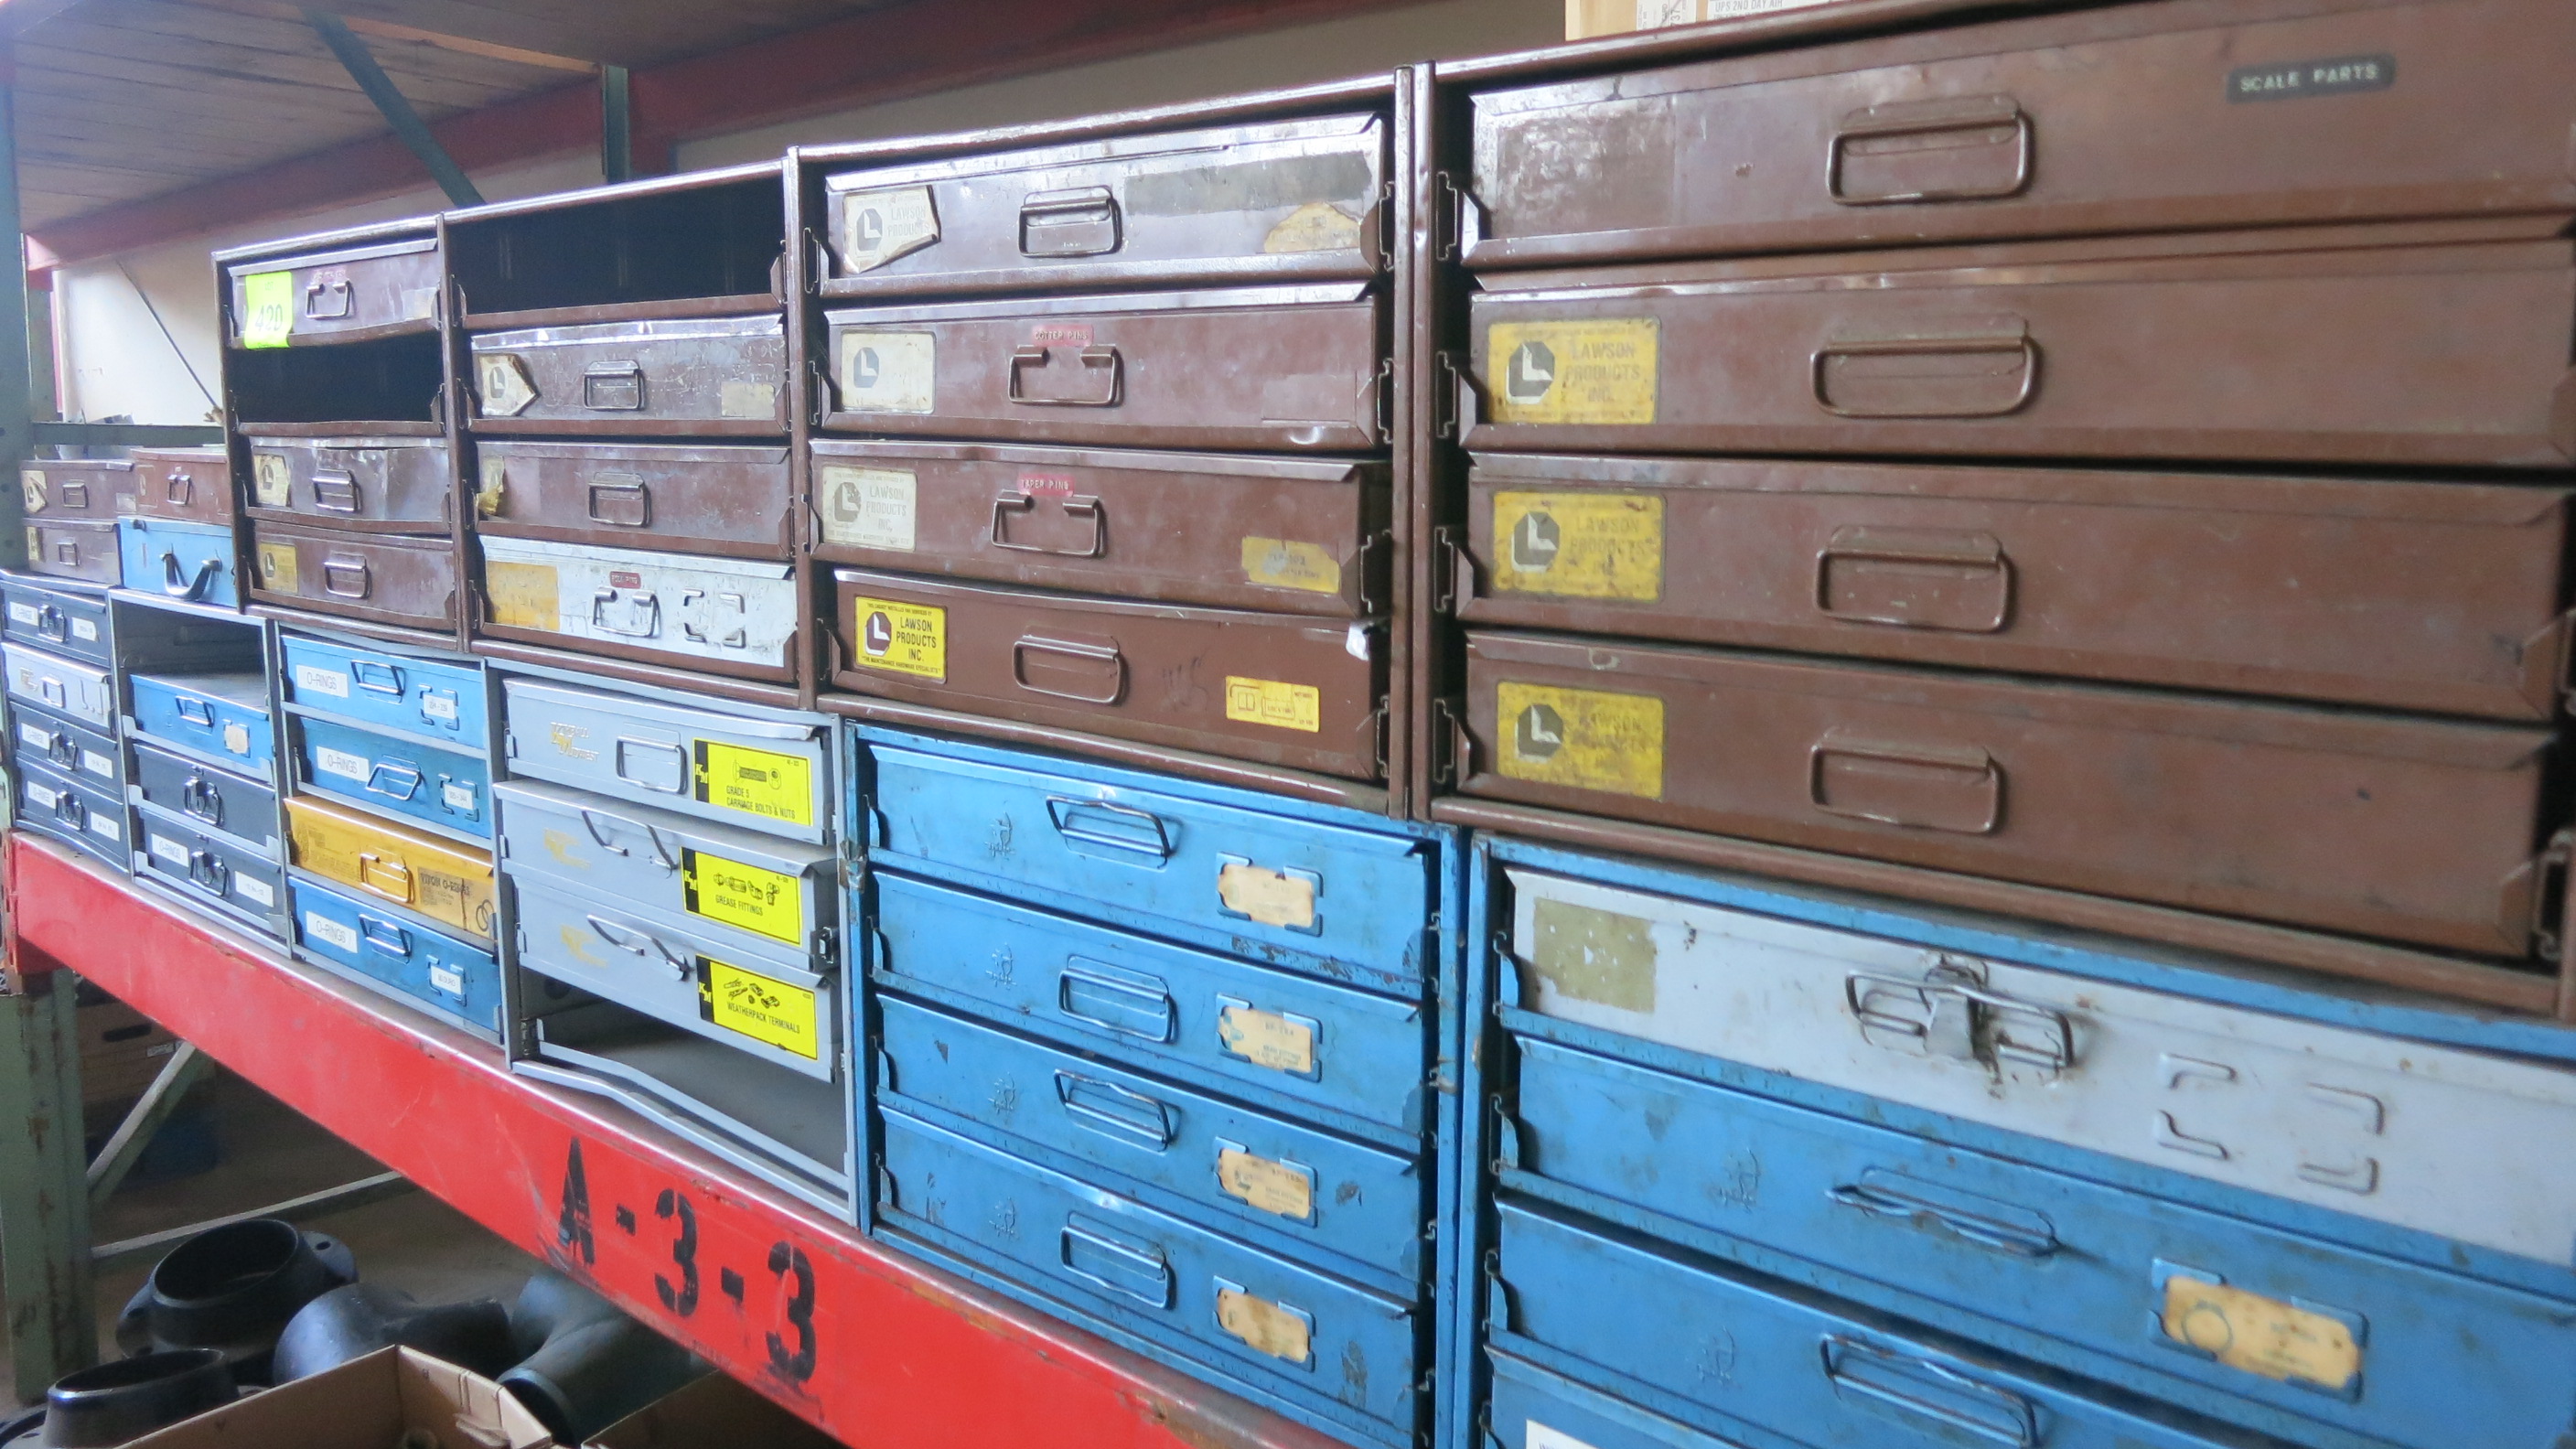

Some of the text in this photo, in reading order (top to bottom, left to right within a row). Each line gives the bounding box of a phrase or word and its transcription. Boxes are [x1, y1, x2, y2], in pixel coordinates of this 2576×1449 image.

[1715, 2, 1731, 12] UPS
[1733, 0, 1748, 11] 2ND
[1751, 0, 1766, 9] DAY
[2240, 62, 2377, 92] SCALE PARTS
[891, 206, 926, 220] LAWSON
[255, 303, 283, 331] 420
[1035, 330, 1089, 340] COTTER PINS
[1571, 341, 1636, 360] LAWSON
[1565, 364, 1640, 381] PRODUCTS
[869, 486, 905, 500] LAWSON
[1022, 479, 1069, 490] TAPER PINS
[865, 500, 907, 516] PRODUCTS
[900, 617, 932, 632] LAWSON
[896, 631, 937, 648] PRODUCTS
[908, 649, 925, 661] INC.
[306, 671, 338, 690] O-RINGS
[327, 755, 358, 775] O-RINGS
[726, 785, 749, 798] GRADE 5
[726, 797, 796, 820] CARRIAGE BOLTS & NUTS
[715, 895, 764, 917] GREASE FITTINGS
[316, 919, 346, 943] O-RINGS
[727, 1001, 800, 1034] WEATHERPACK TERMINALS
[558, 1137, 816, 1382] A-3-3
